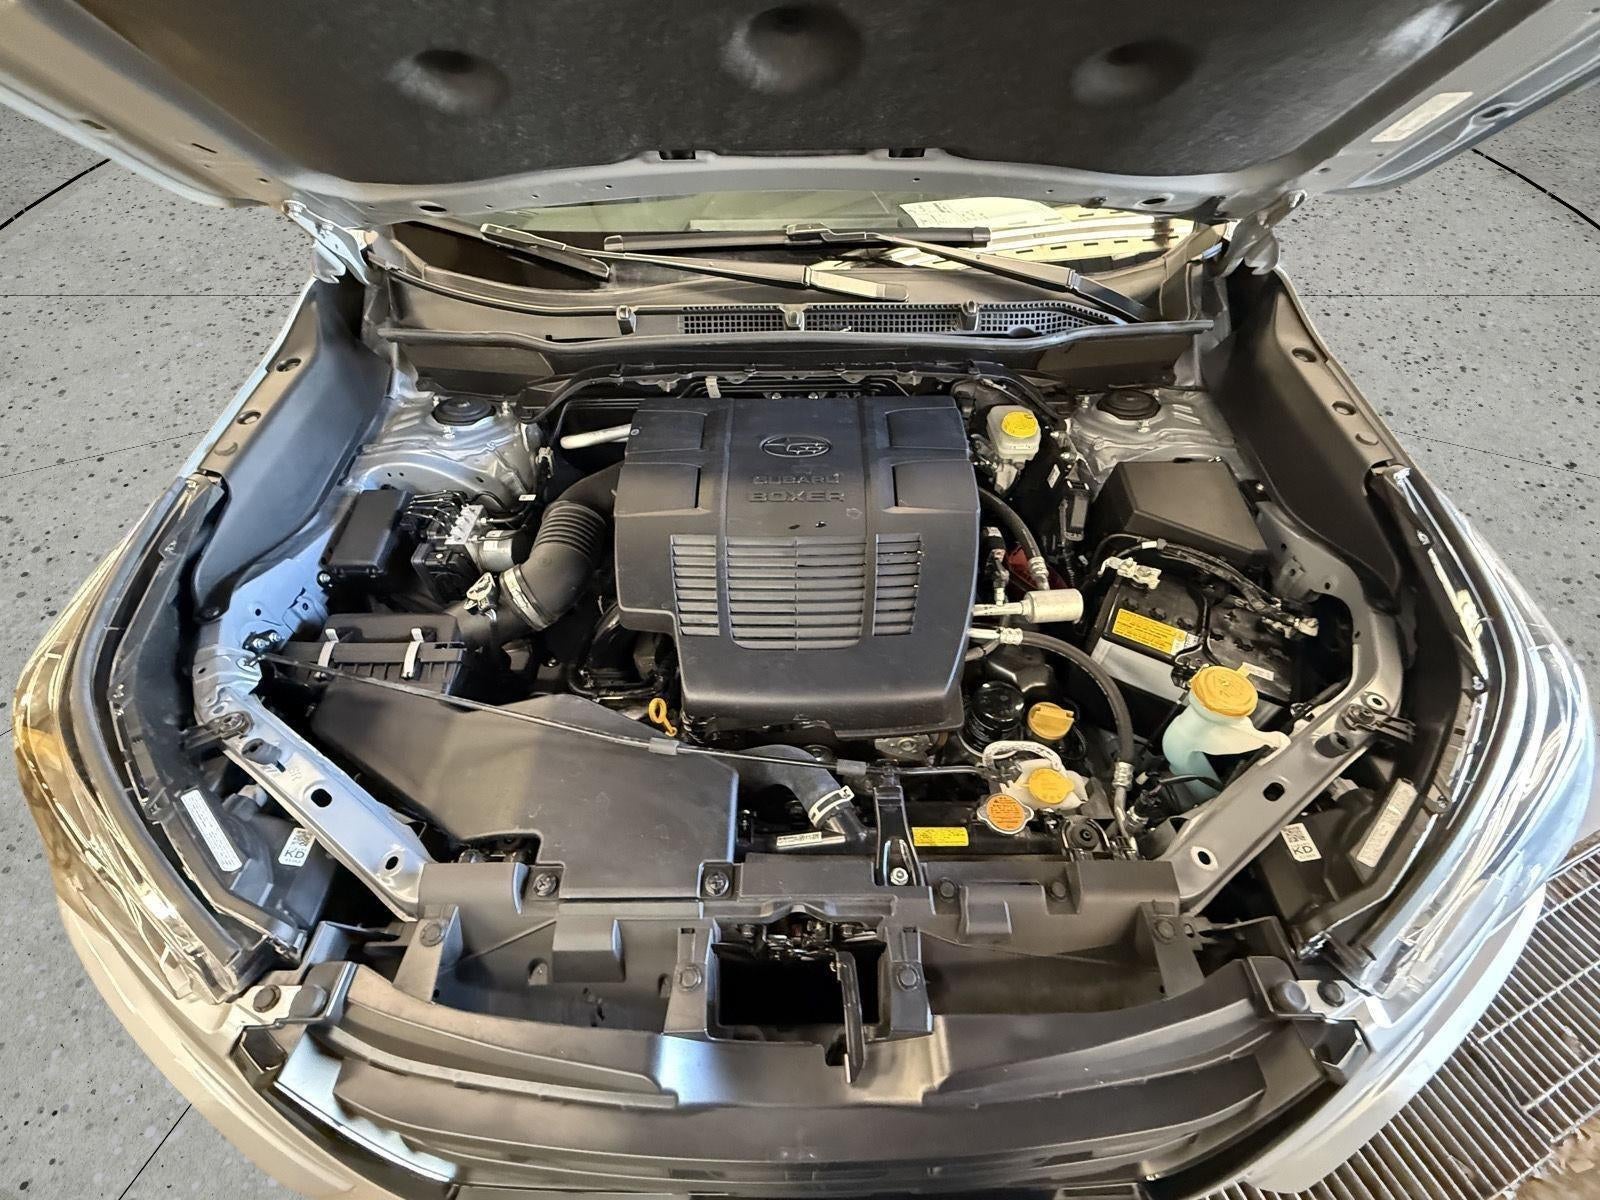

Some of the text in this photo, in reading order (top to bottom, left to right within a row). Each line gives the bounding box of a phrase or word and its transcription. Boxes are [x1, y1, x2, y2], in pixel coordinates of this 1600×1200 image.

[751, 473, 840, 485] SUBARU
[748, 490, 845, 503] BOXER
[284, 849, 305, 859] KD
[1292, 845, 1313, 855] KD
